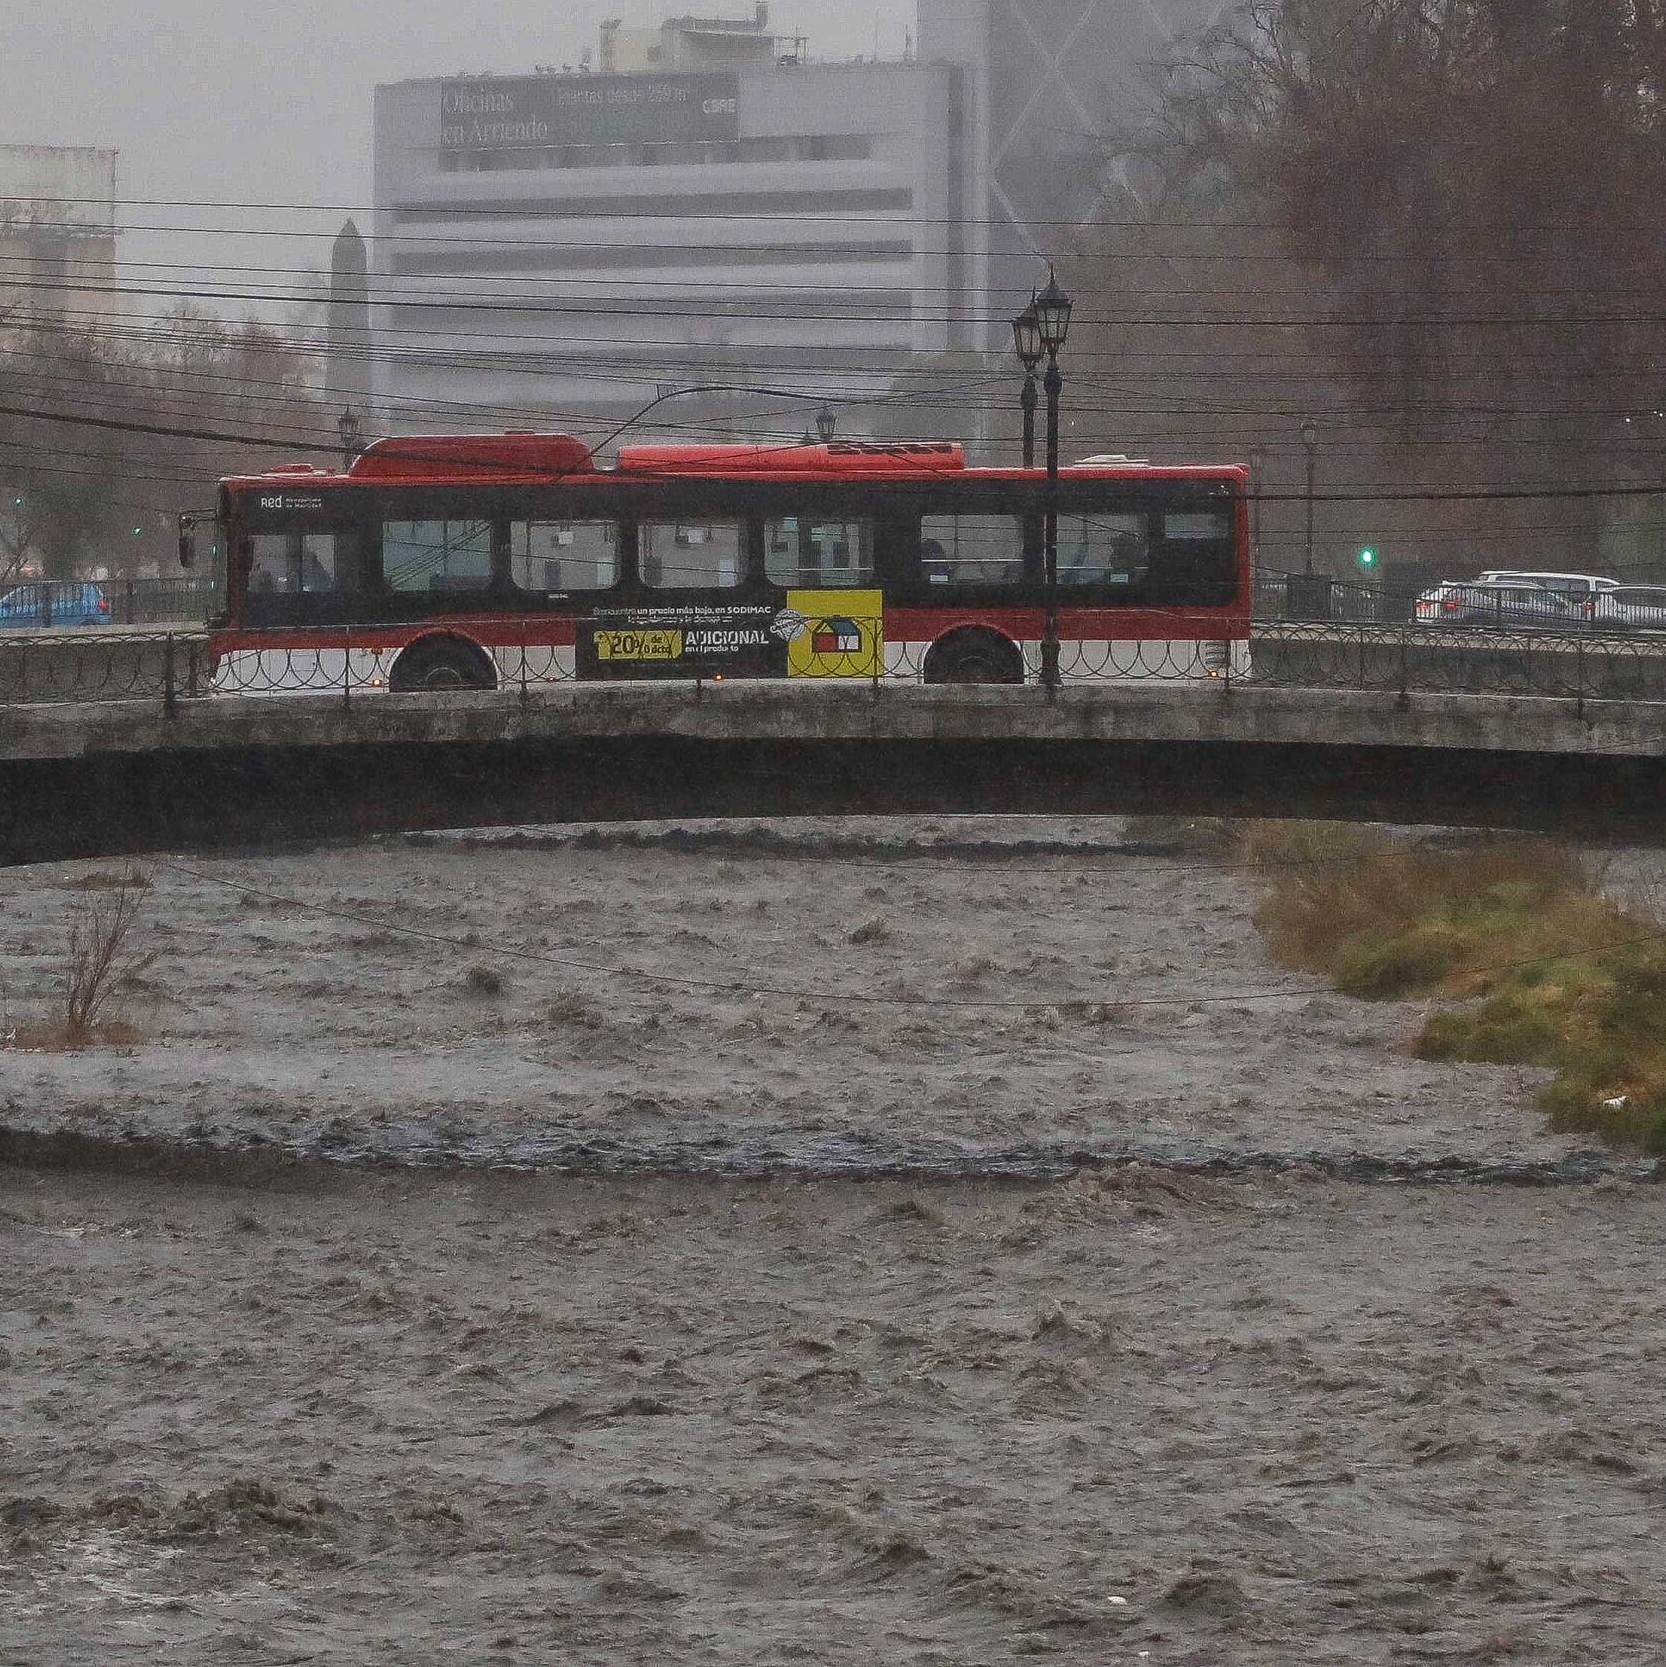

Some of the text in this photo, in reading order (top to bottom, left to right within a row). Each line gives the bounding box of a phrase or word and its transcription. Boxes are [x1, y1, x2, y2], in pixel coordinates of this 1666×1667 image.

[261, 495, 283, 508] Red
[649, 606, 675, 616] precio
[727, 606, 771, 614] SODIMAC
[685, 630, 769, 645] ADICIONAL
